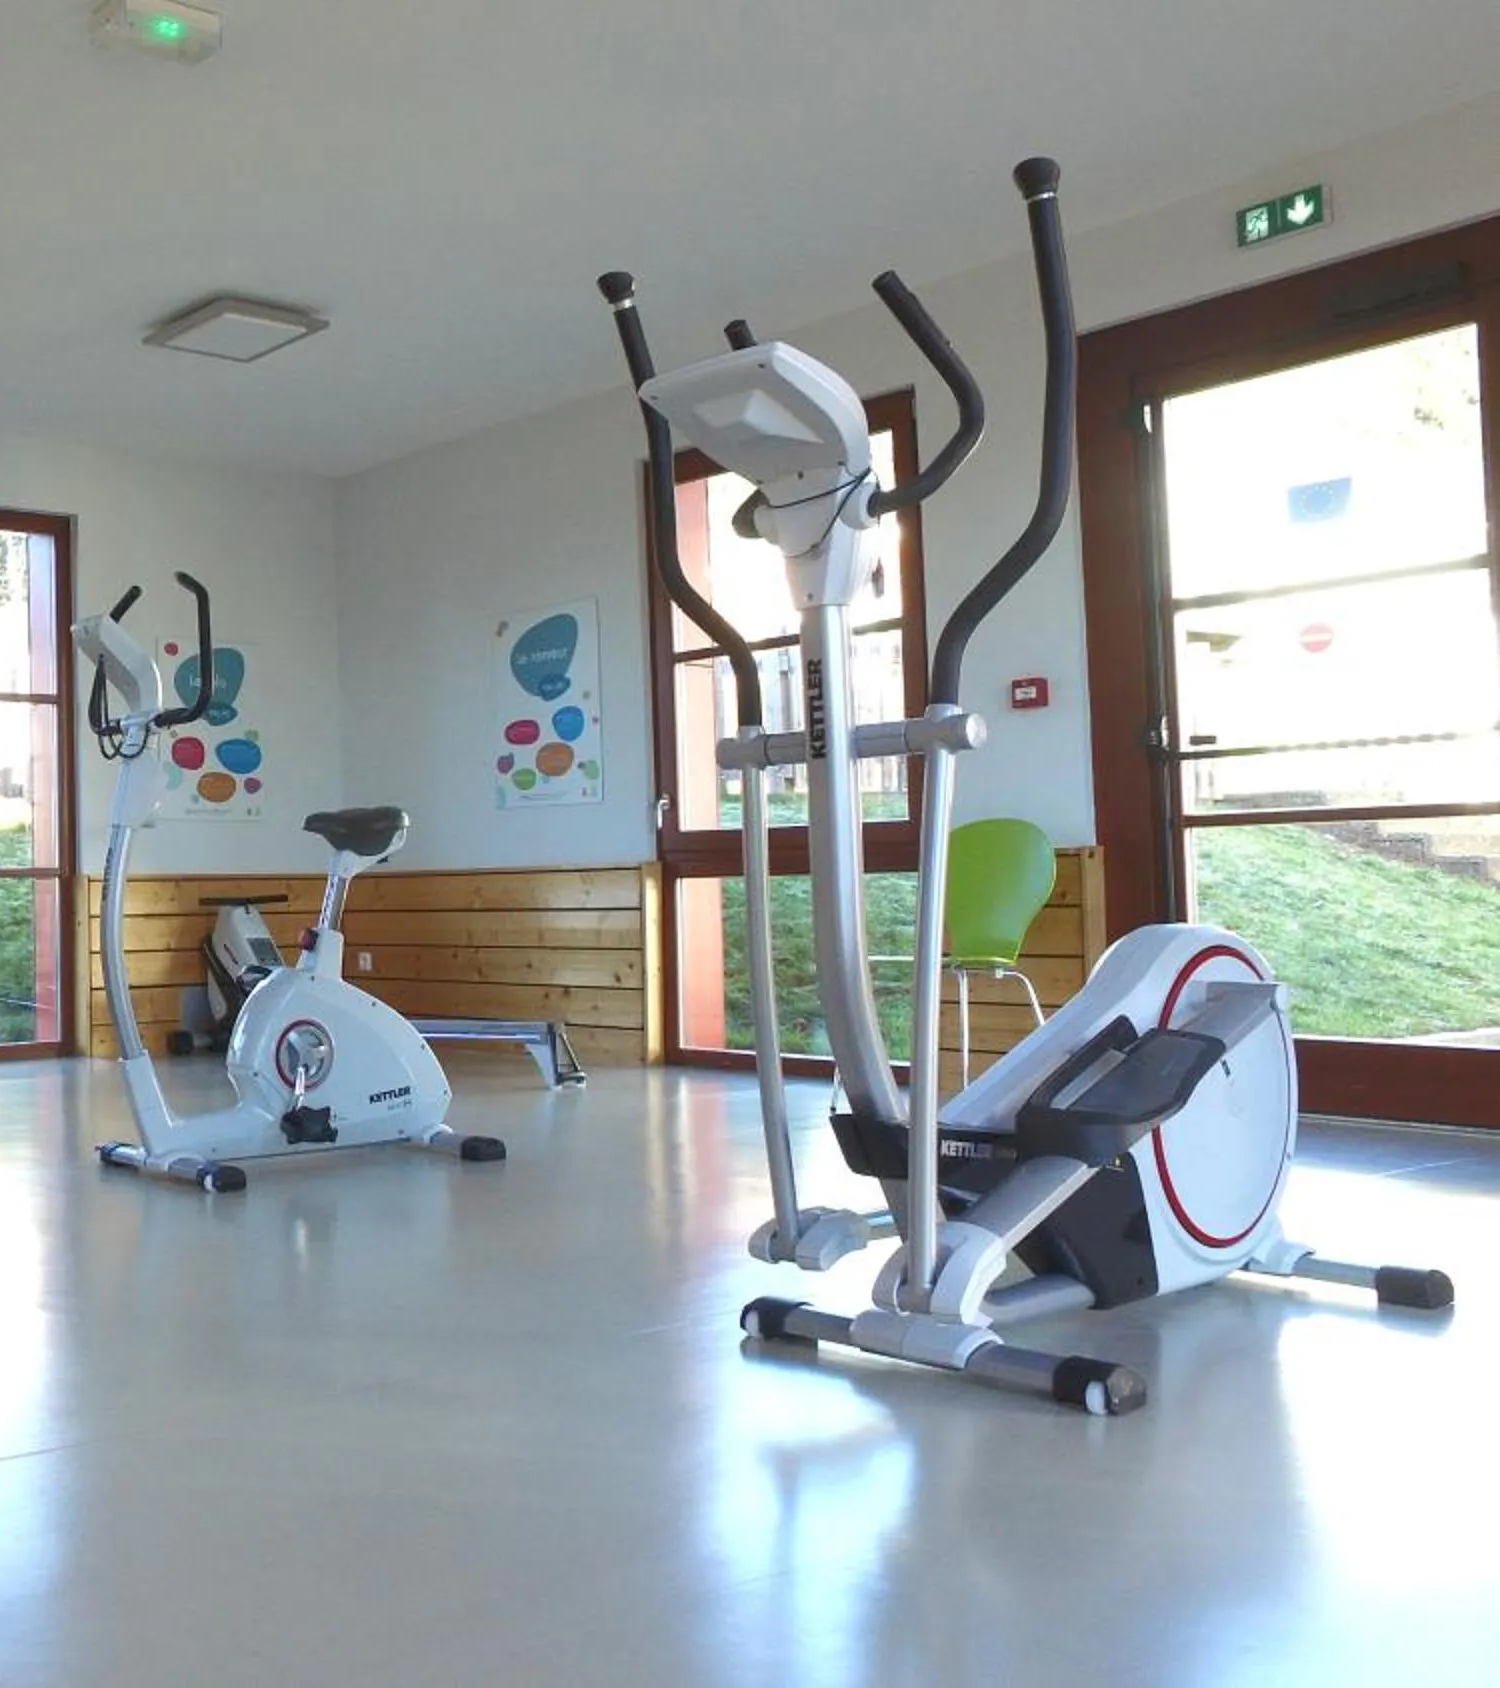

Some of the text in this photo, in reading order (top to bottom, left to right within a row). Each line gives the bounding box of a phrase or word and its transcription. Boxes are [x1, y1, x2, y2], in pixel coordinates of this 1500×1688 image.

[808, 659, 826, 759] KETTLER
[369, 1085, 411, 1105] KETTLER
[941, 1139, 993, 1160] KETTLER
